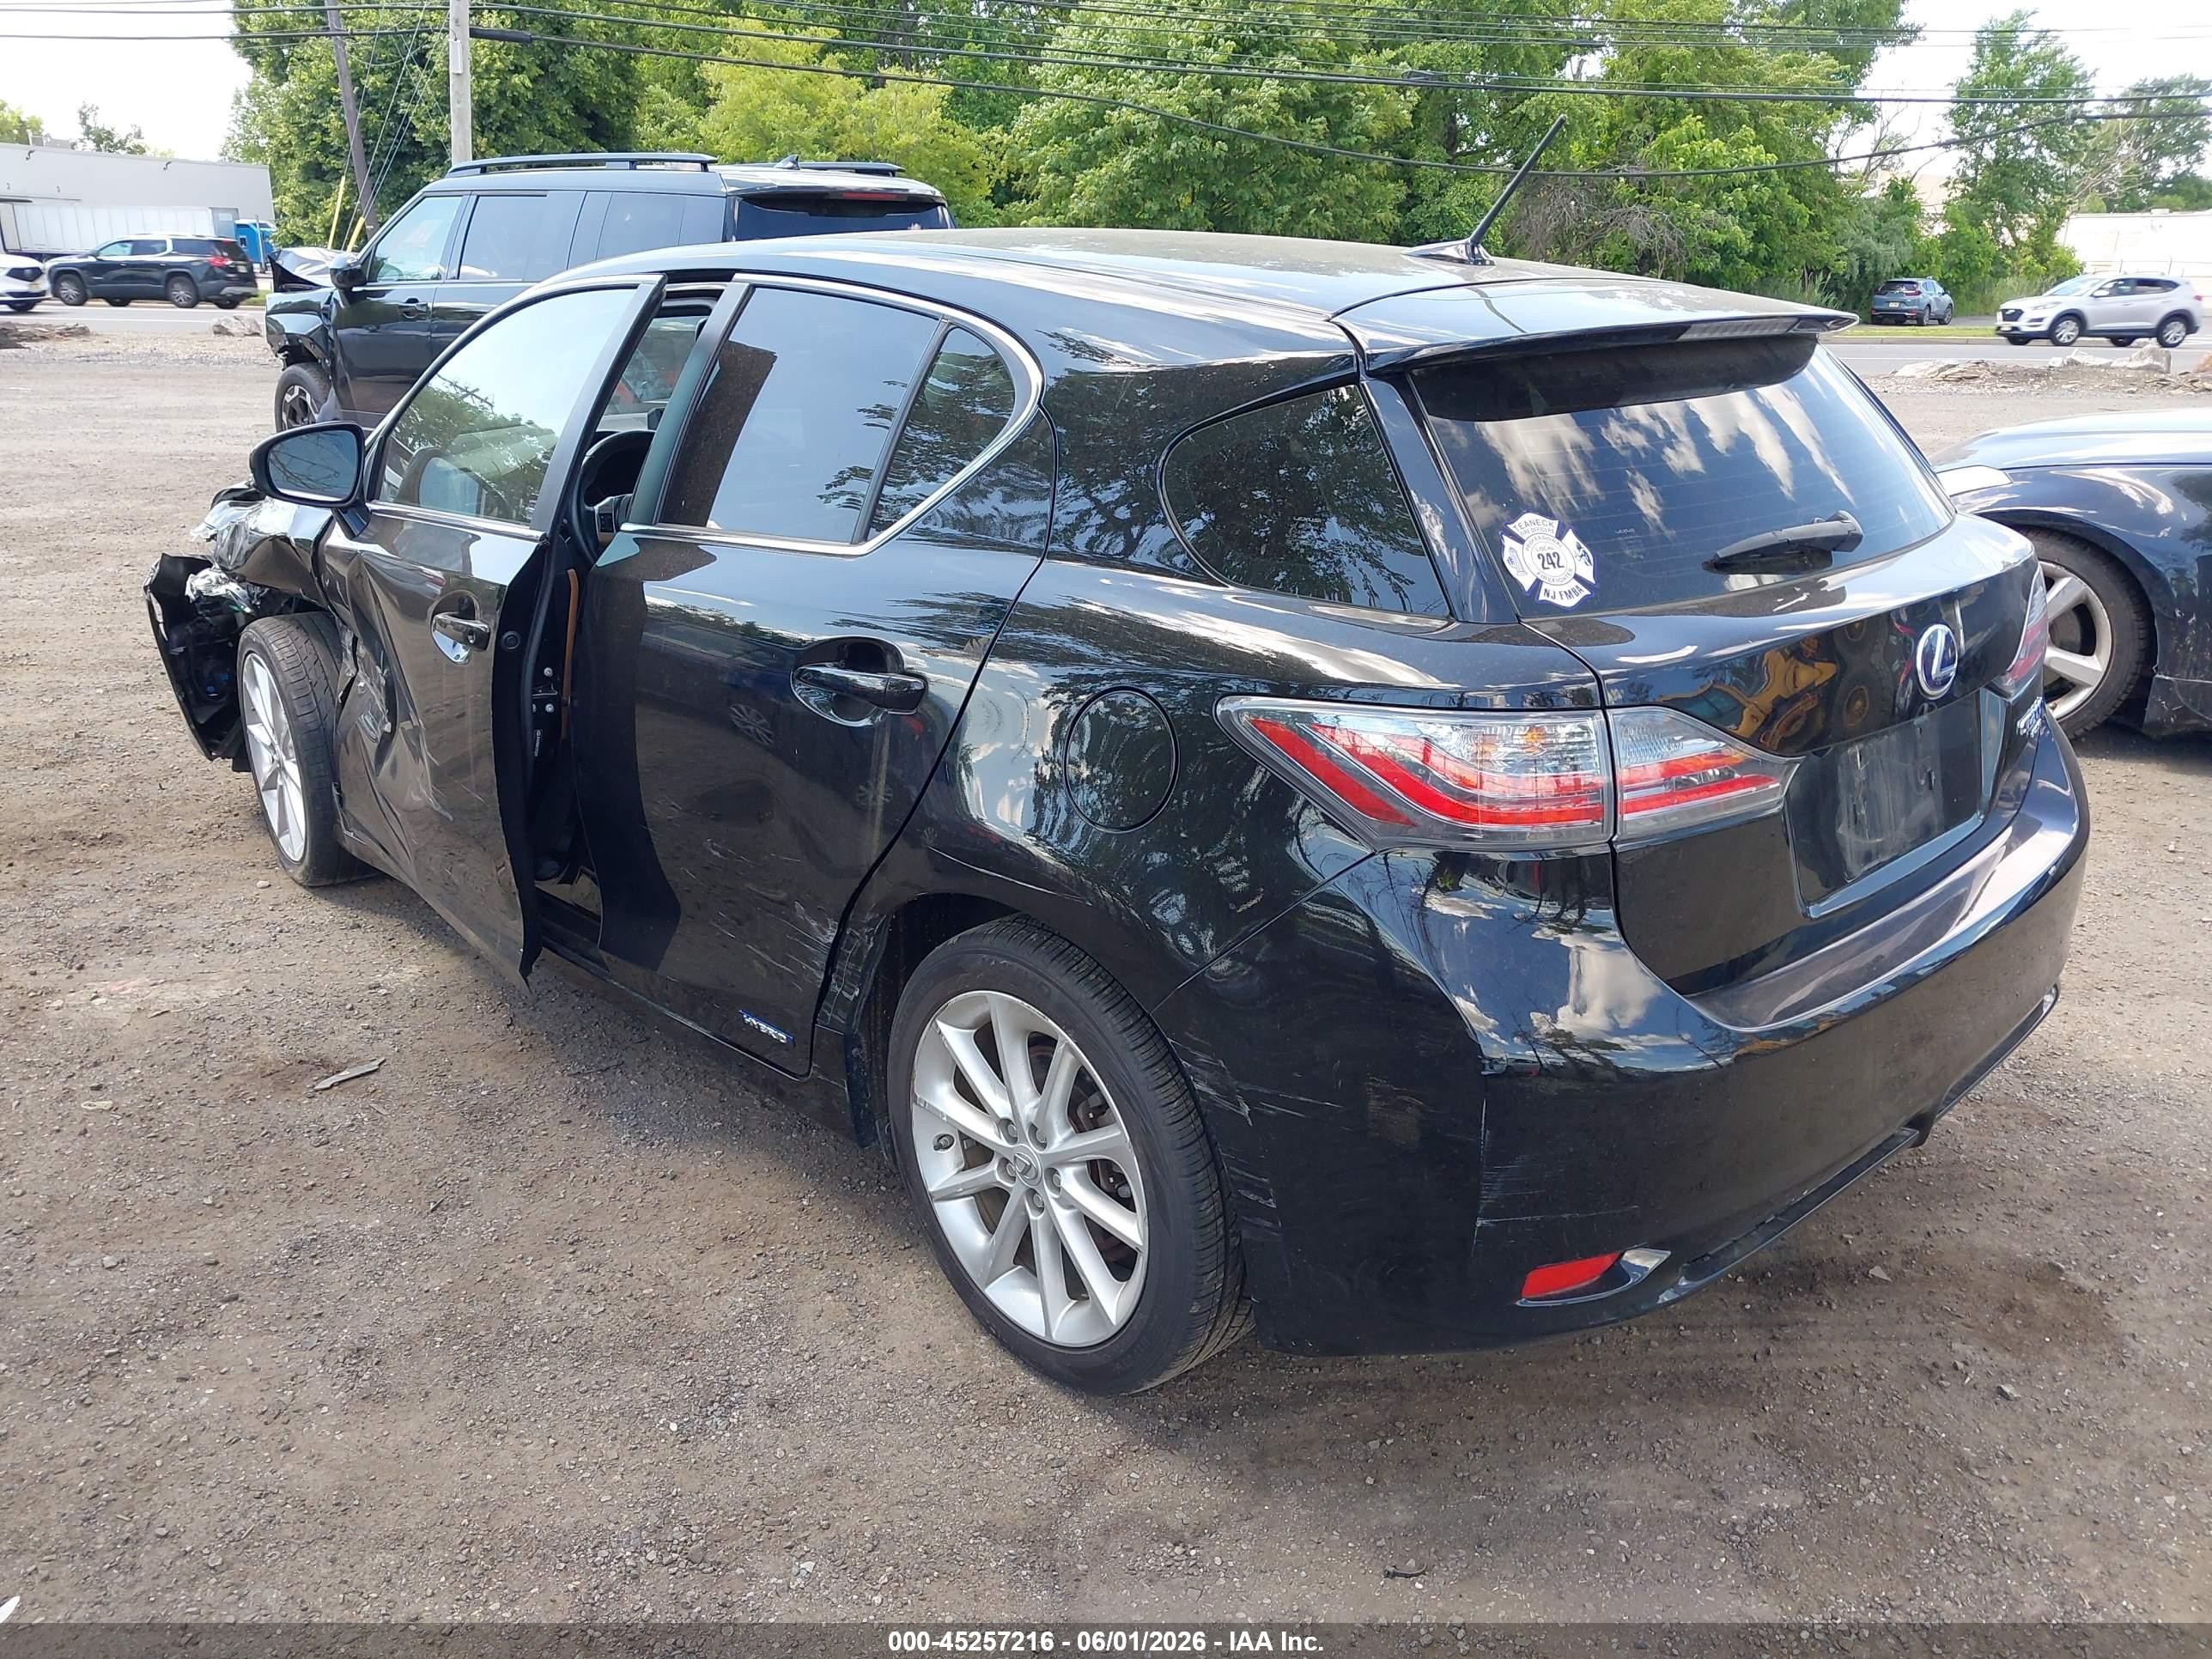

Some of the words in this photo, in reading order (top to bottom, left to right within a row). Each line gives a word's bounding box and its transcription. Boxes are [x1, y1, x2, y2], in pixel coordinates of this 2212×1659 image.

[1513, 519, 1555, 532] TEANECK
[1537, 551, 1565, 570] 242
[1543, 587, 1556, 600] NJ
[1558, 585, 1584, 600] FMBA
